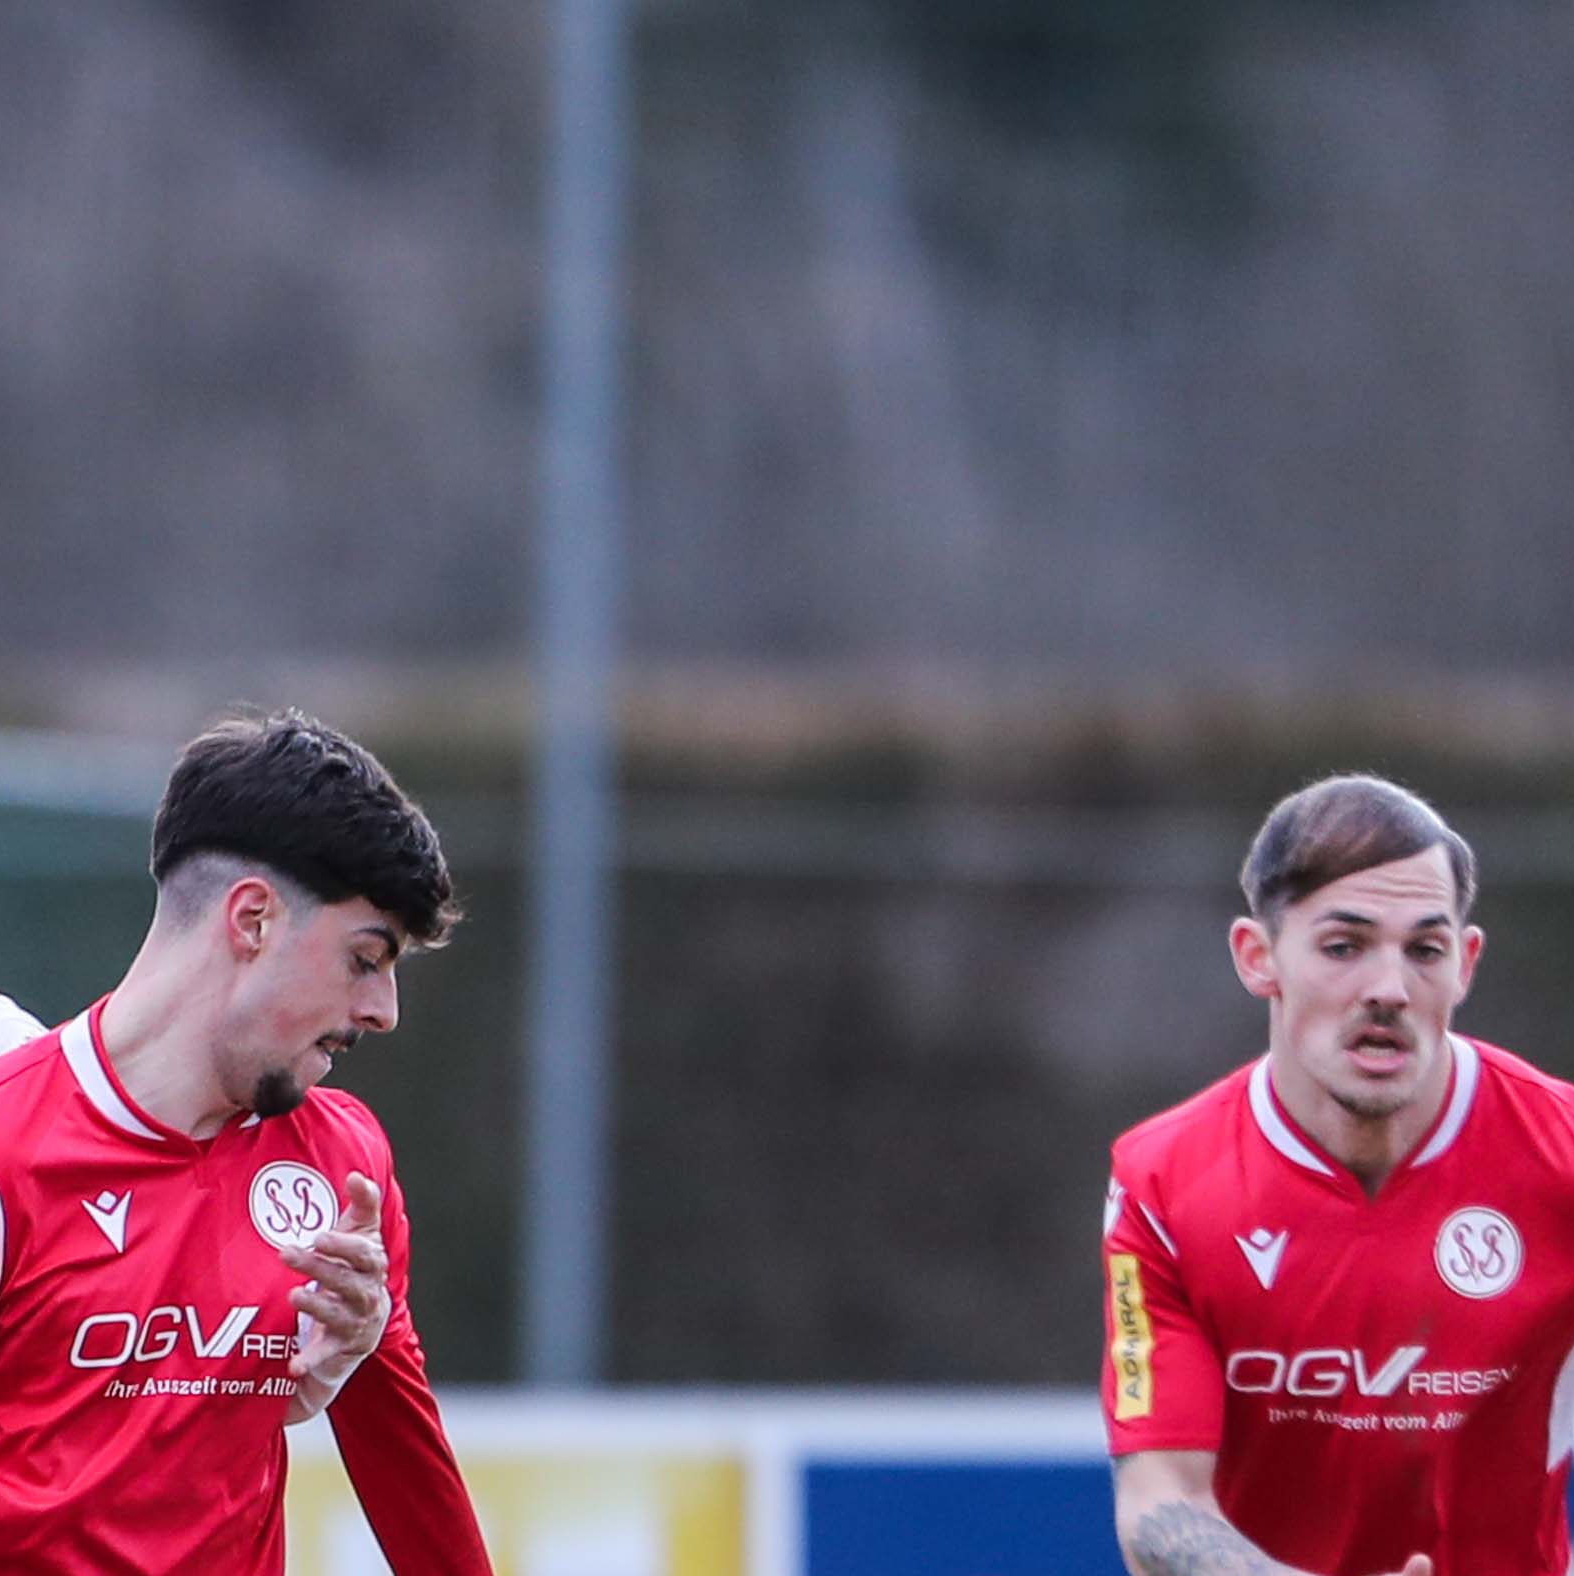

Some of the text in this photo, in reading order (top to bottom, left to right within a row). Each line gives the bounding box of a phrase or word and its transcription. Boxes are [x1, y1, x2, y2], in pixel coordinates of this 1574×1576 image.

[69, 1305, 260, 1369] OGV
[1116, 1270, 1142, 1400] ADMIRAL
[141, 1376, 217, 1397] Auszeit
[221, 1380, 255, 1395] vom
[1226, 1345, 1427, 1397] OGV
[1383, 1415, 1426, 1431] vom
